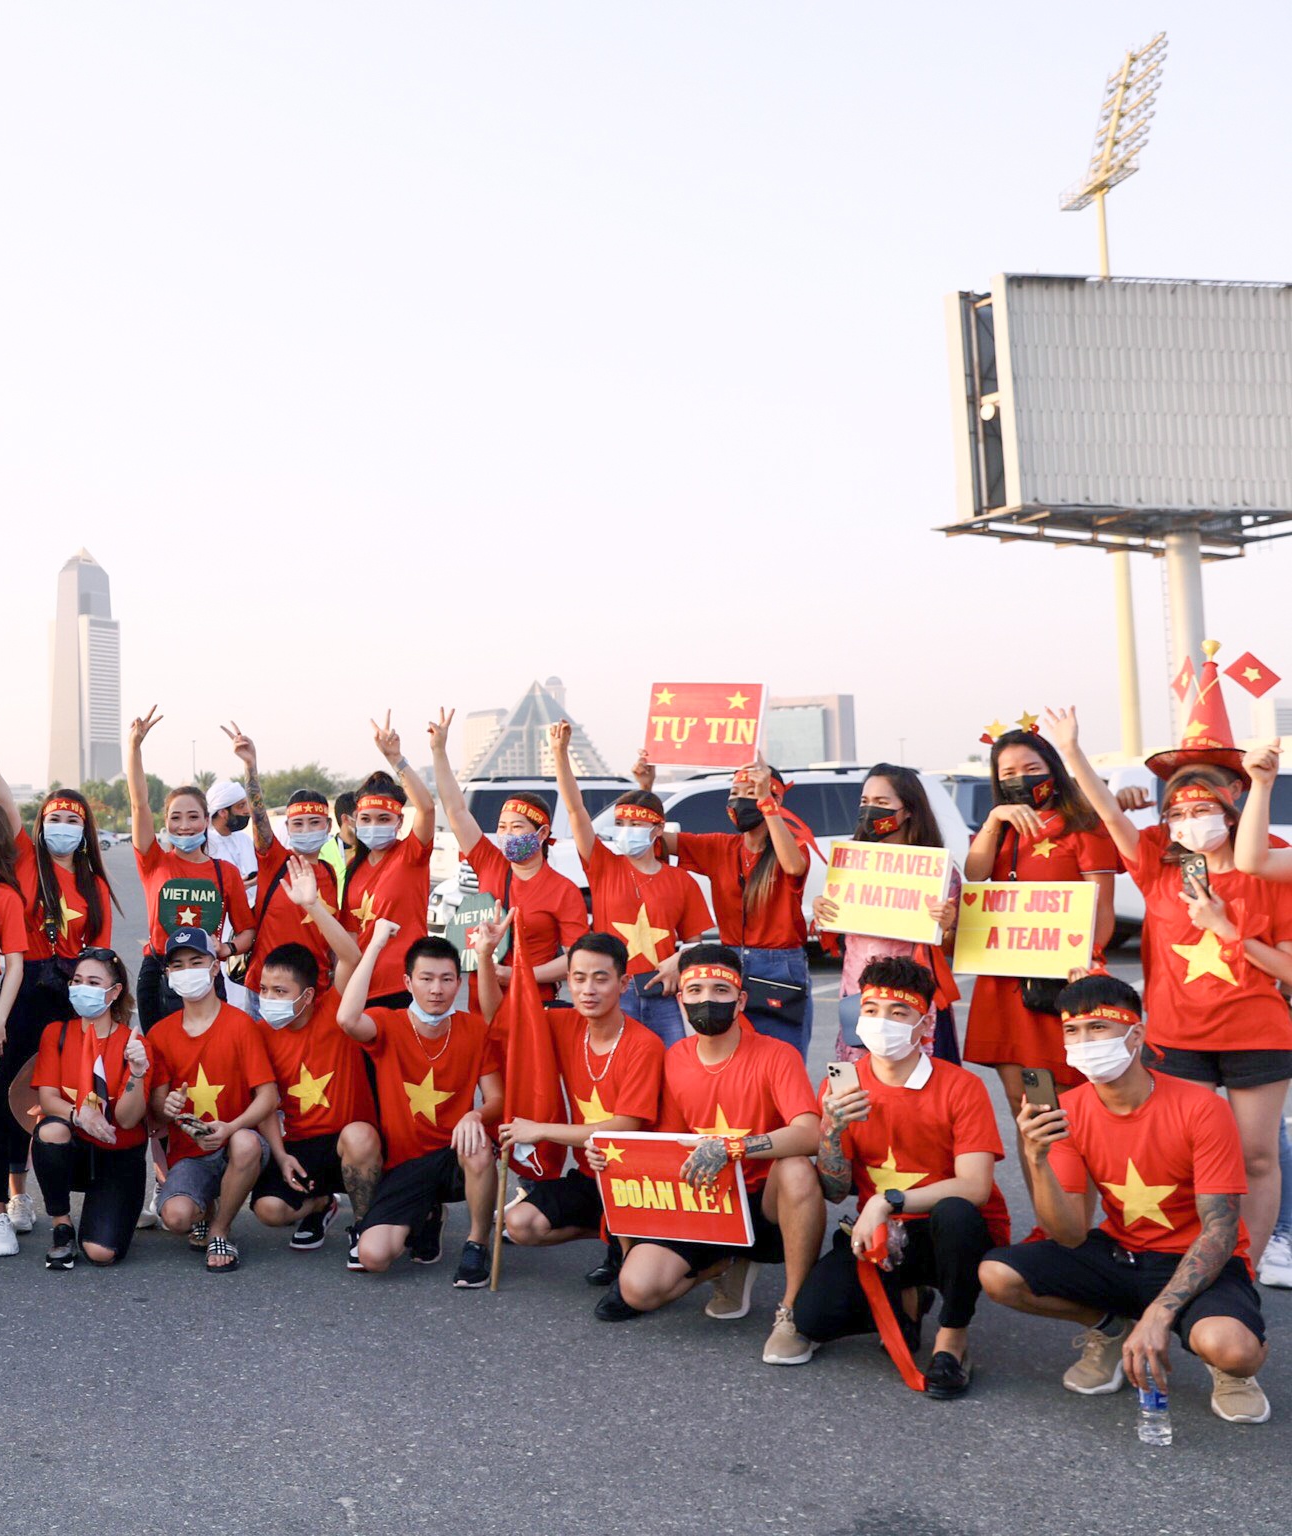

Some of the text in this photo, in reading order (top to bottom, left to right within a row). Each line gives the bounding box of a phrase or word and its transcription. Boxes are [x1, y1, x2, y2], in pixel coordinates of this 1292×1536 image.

[651, 715, 758, 749] TỰ TIN
[635, 808, 647, 818] VÔ
[831, 847, 945, 878] HERE TRAVELS
[162, 887, 216, 902] VIET NAM
[843, 882, 922, 911] A NATION
[982, 889, 1074, 913] NOT JUST
[453, 910, 479, 925] VIET
[985, 926, 1061, 951] A TEAM
[610, 1175, 677, 1211] ĐOÀN
